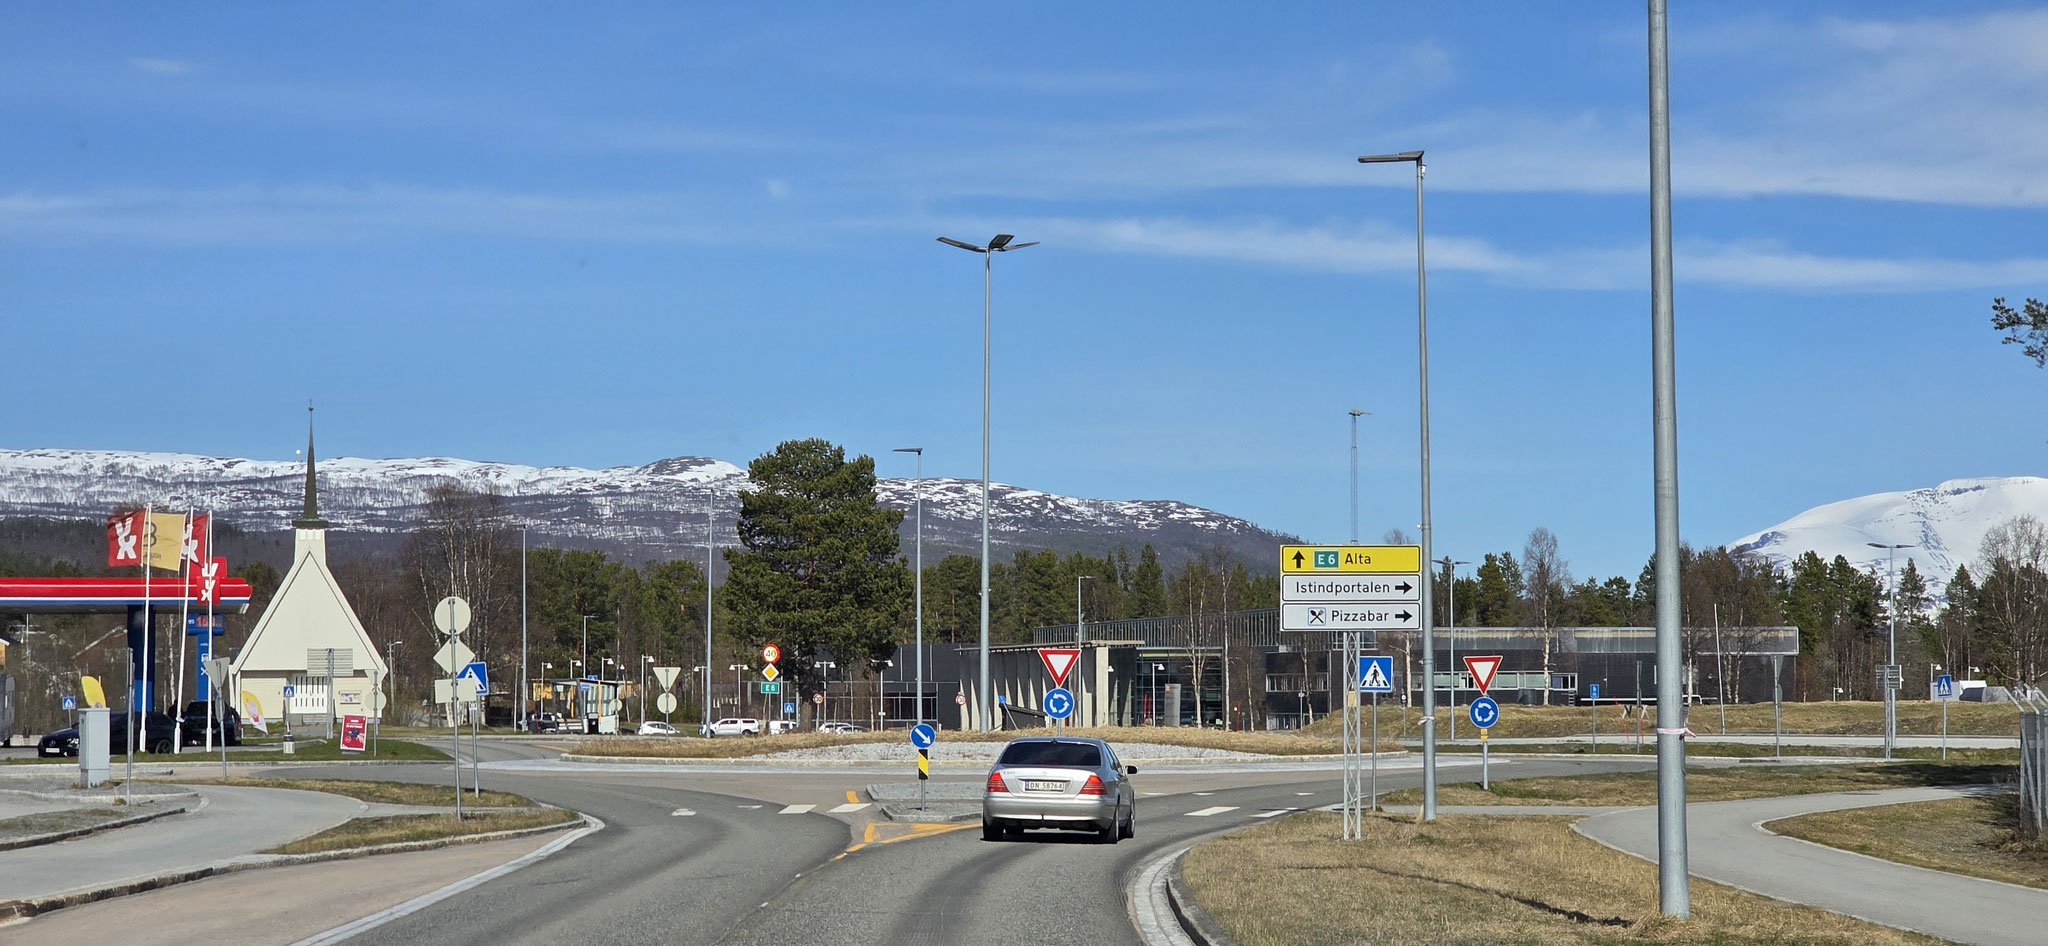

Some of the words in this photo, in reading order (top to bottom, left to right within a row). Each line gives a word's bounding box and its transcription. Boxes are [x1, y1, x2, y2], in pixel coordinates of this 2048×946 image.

[1345, 553, 1371, 565] Alta
[1296, 581, 1390, 596] Istindportalen
[1332, 610, 1389, 622] Pizzabar
